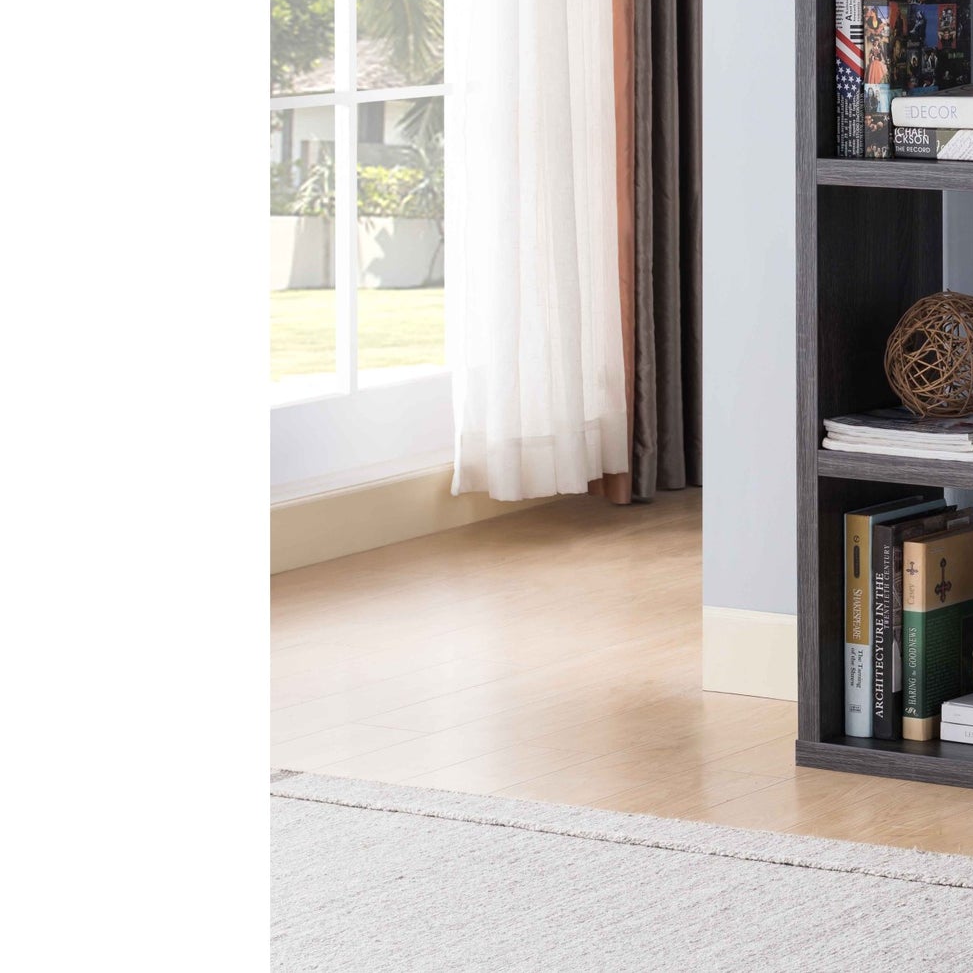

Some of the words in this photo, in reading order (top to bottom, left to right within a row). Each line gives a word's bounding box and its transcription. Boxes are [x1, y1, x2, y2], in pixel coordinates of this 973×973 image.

[910, 105, 958, 119] DECOR
[906, 146, 931, 154] RECORD
[875, 573, 884, 599] THE
[875, 603, 884, 616] IN
[908, 627, 917, 646] NEWS
[908, 646, 917, 668] GOOD
